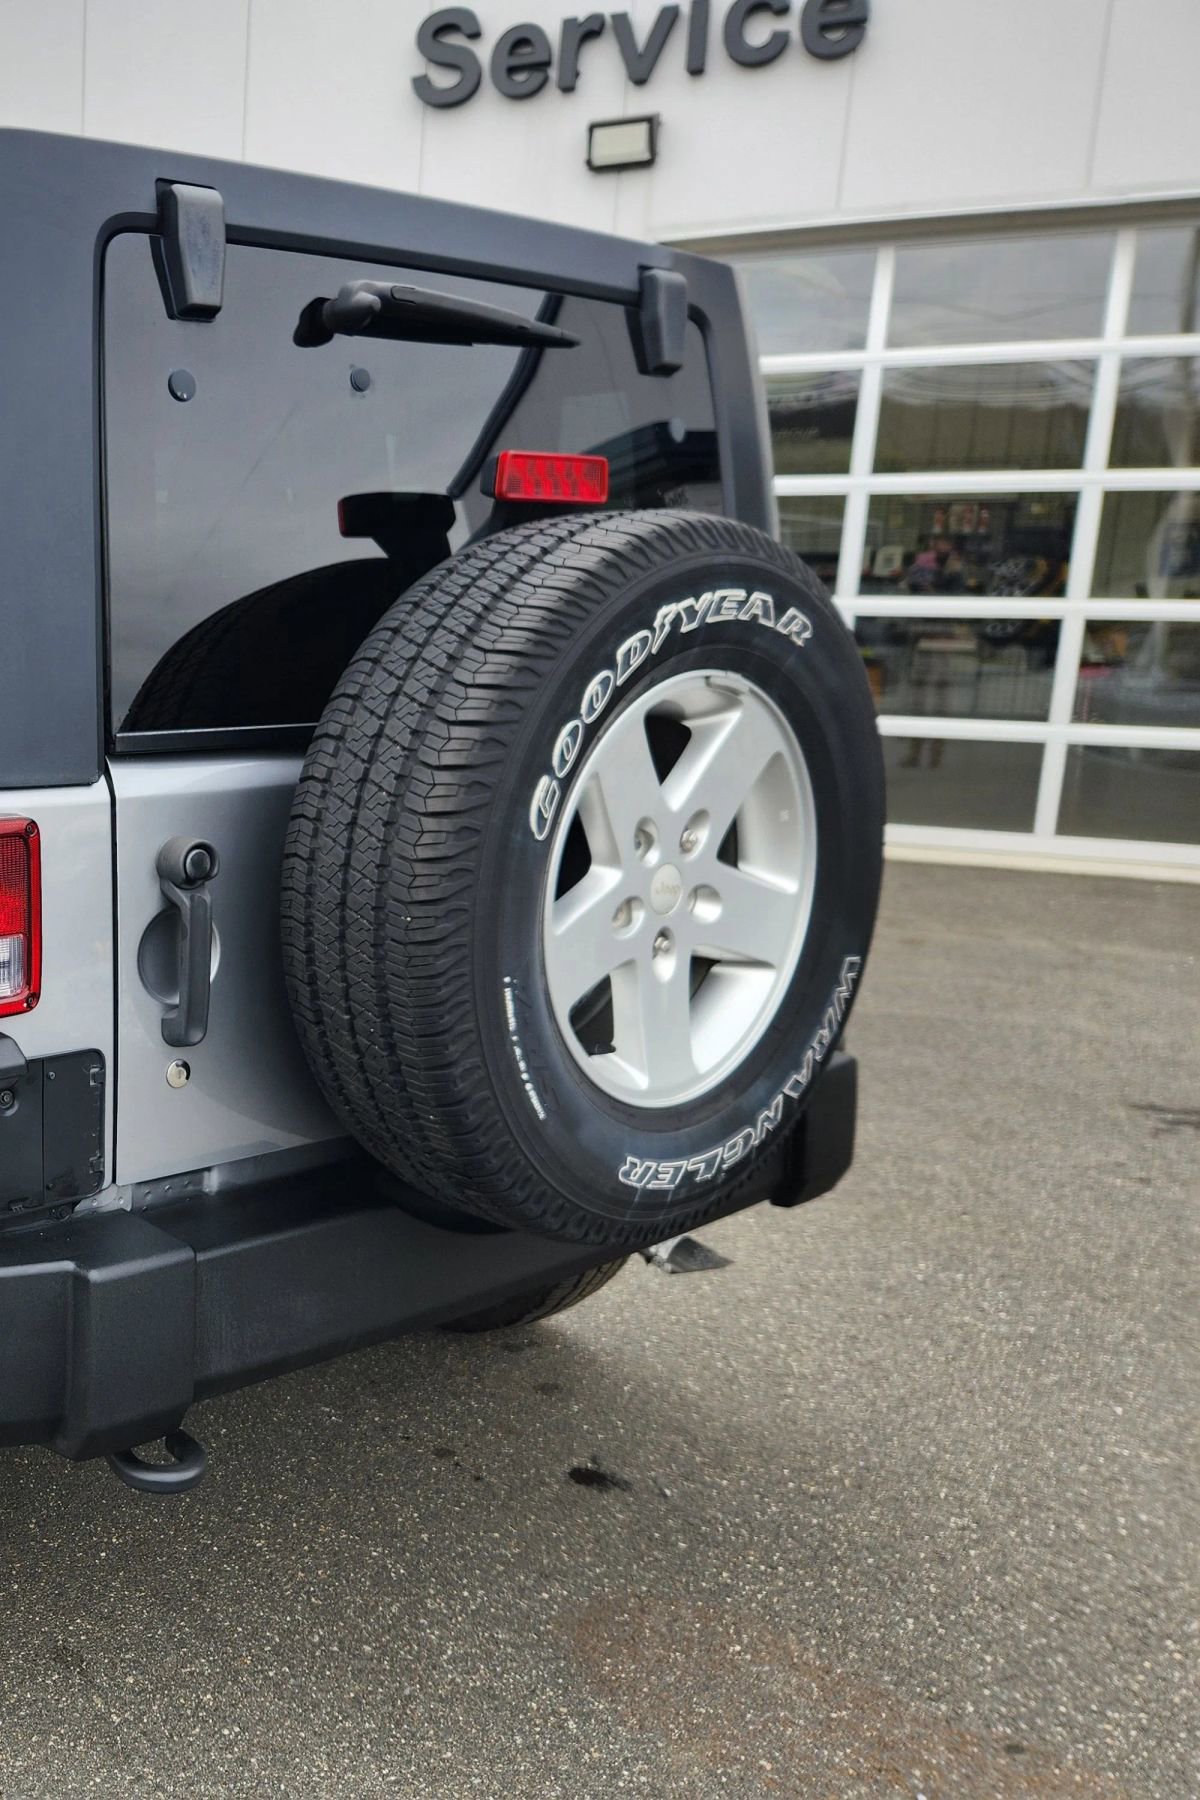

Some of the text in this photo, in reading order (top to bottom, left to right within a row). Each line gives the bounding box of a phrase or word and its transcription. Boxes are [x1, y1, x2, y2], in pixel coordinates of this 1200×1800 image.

[412, 0, 870, 108] Service
[529, 588, 813, 842] GOODYEAR
[618, 955, 861, 1190] WRANGLER
